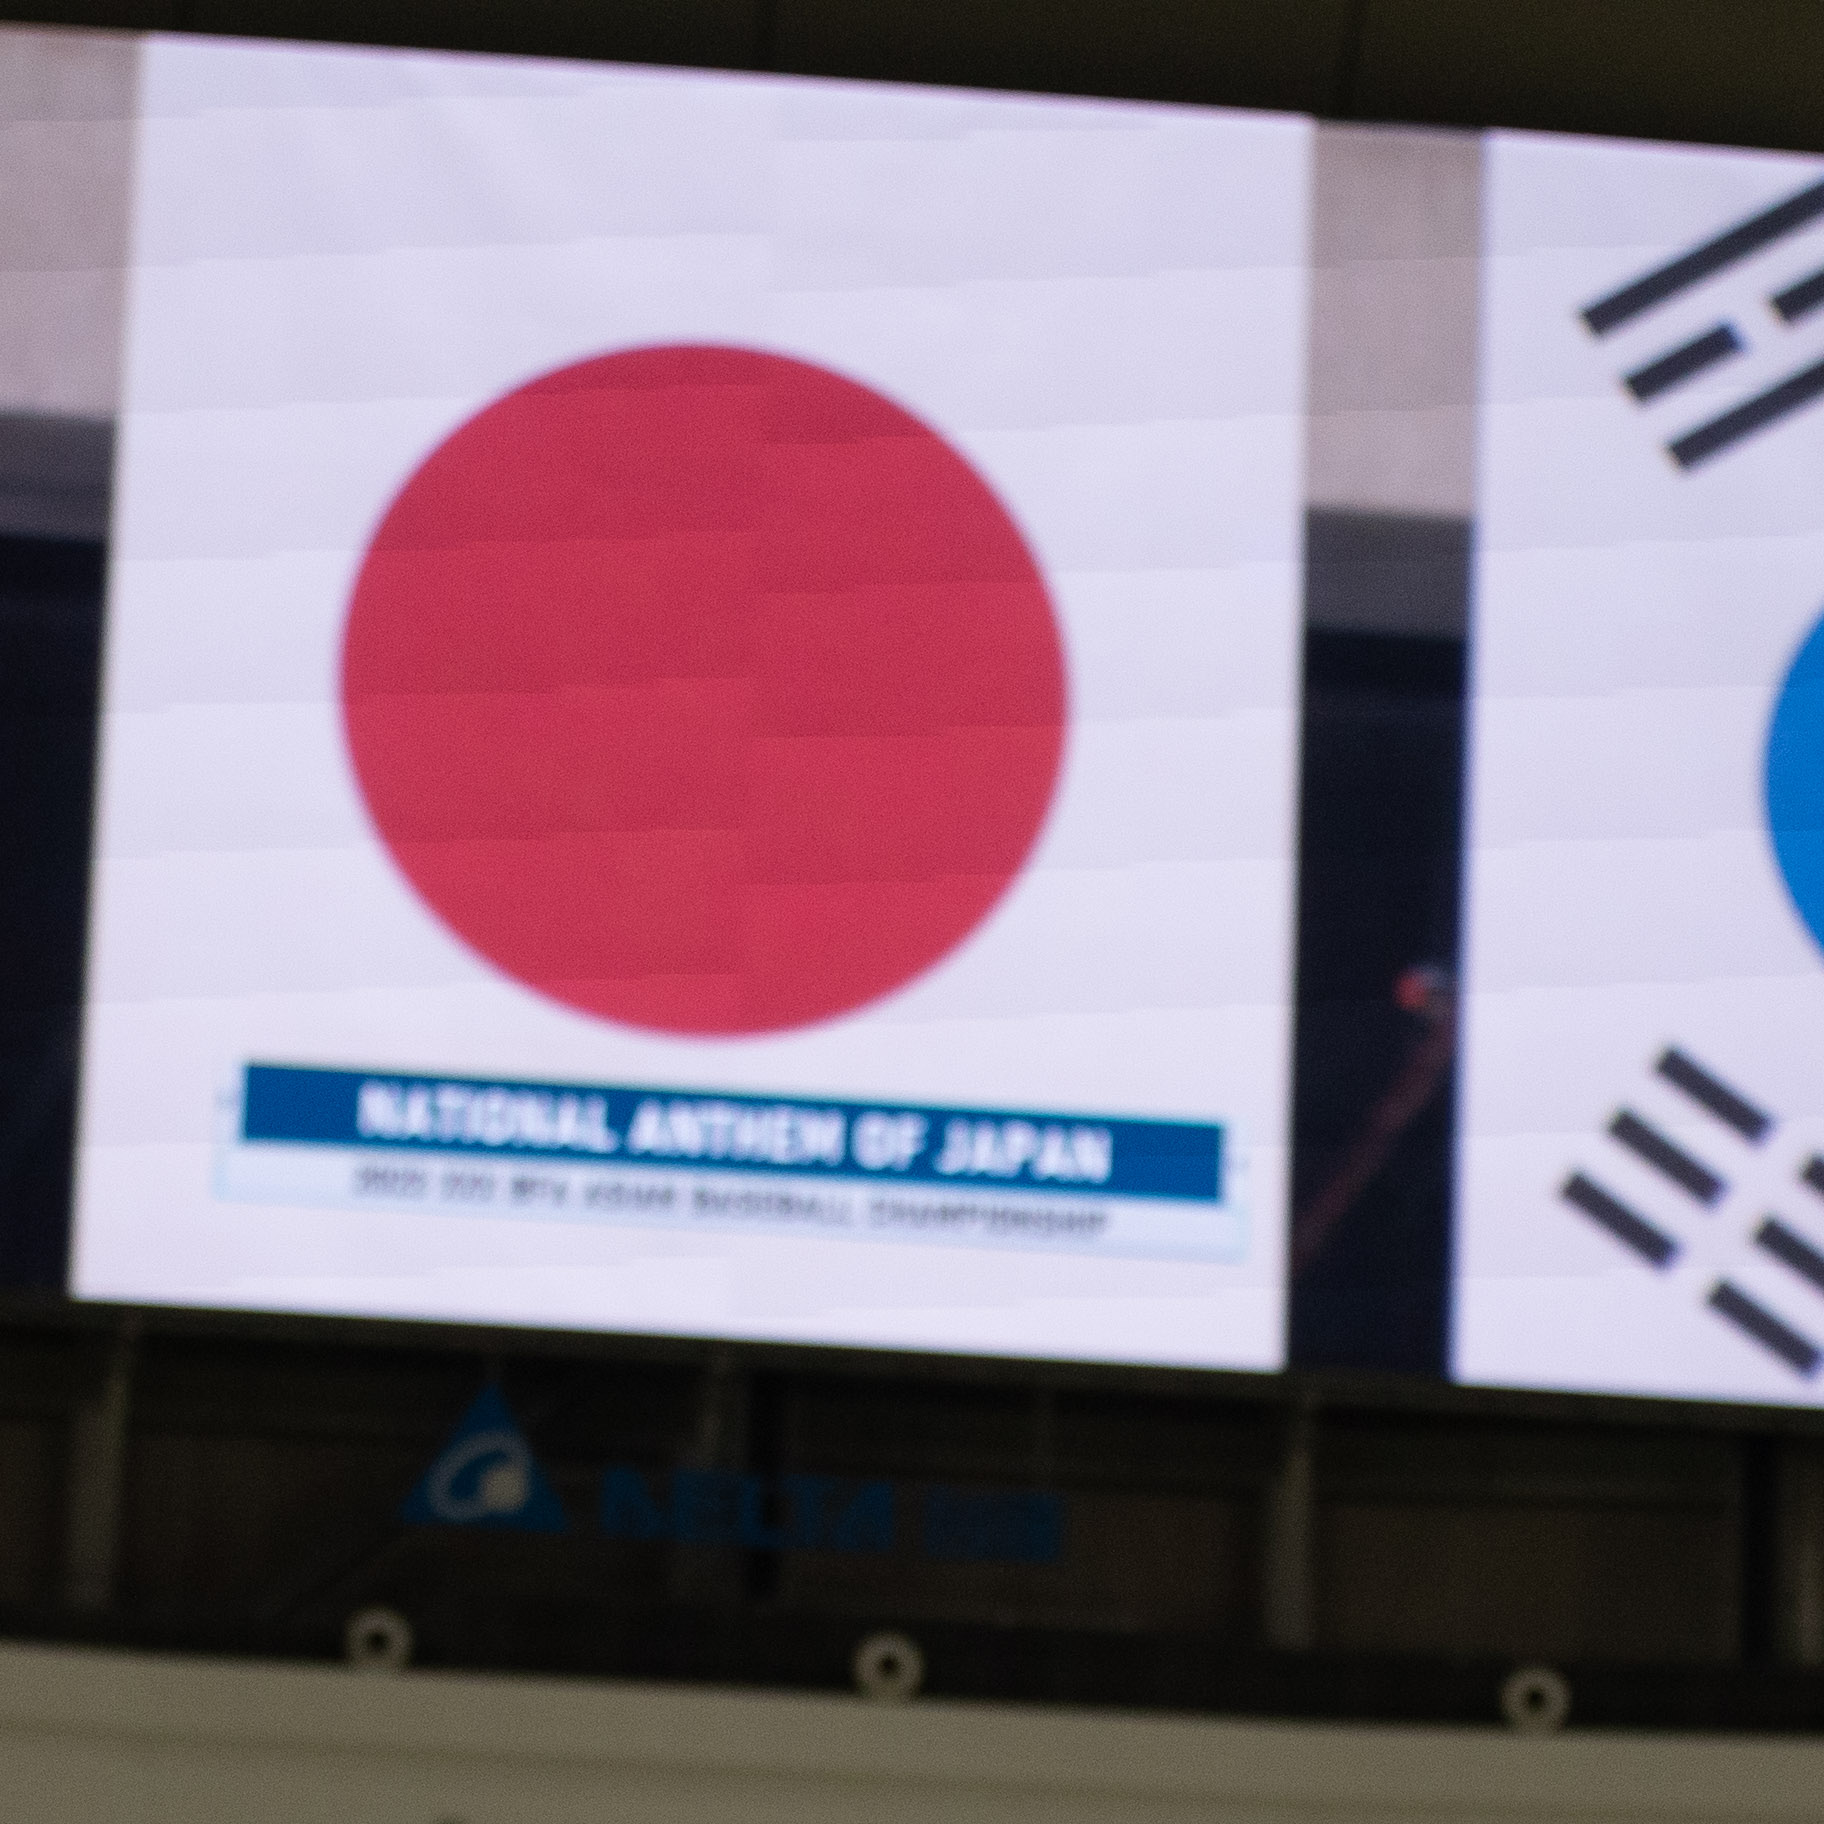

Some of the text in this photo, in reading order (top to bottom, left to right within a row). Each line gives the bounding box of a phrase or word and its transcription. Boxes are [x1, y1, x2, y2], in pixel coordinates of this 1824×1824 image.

[357, 1079, 1113, 1184] NATIONAL ANTHEM OF JAPAN
